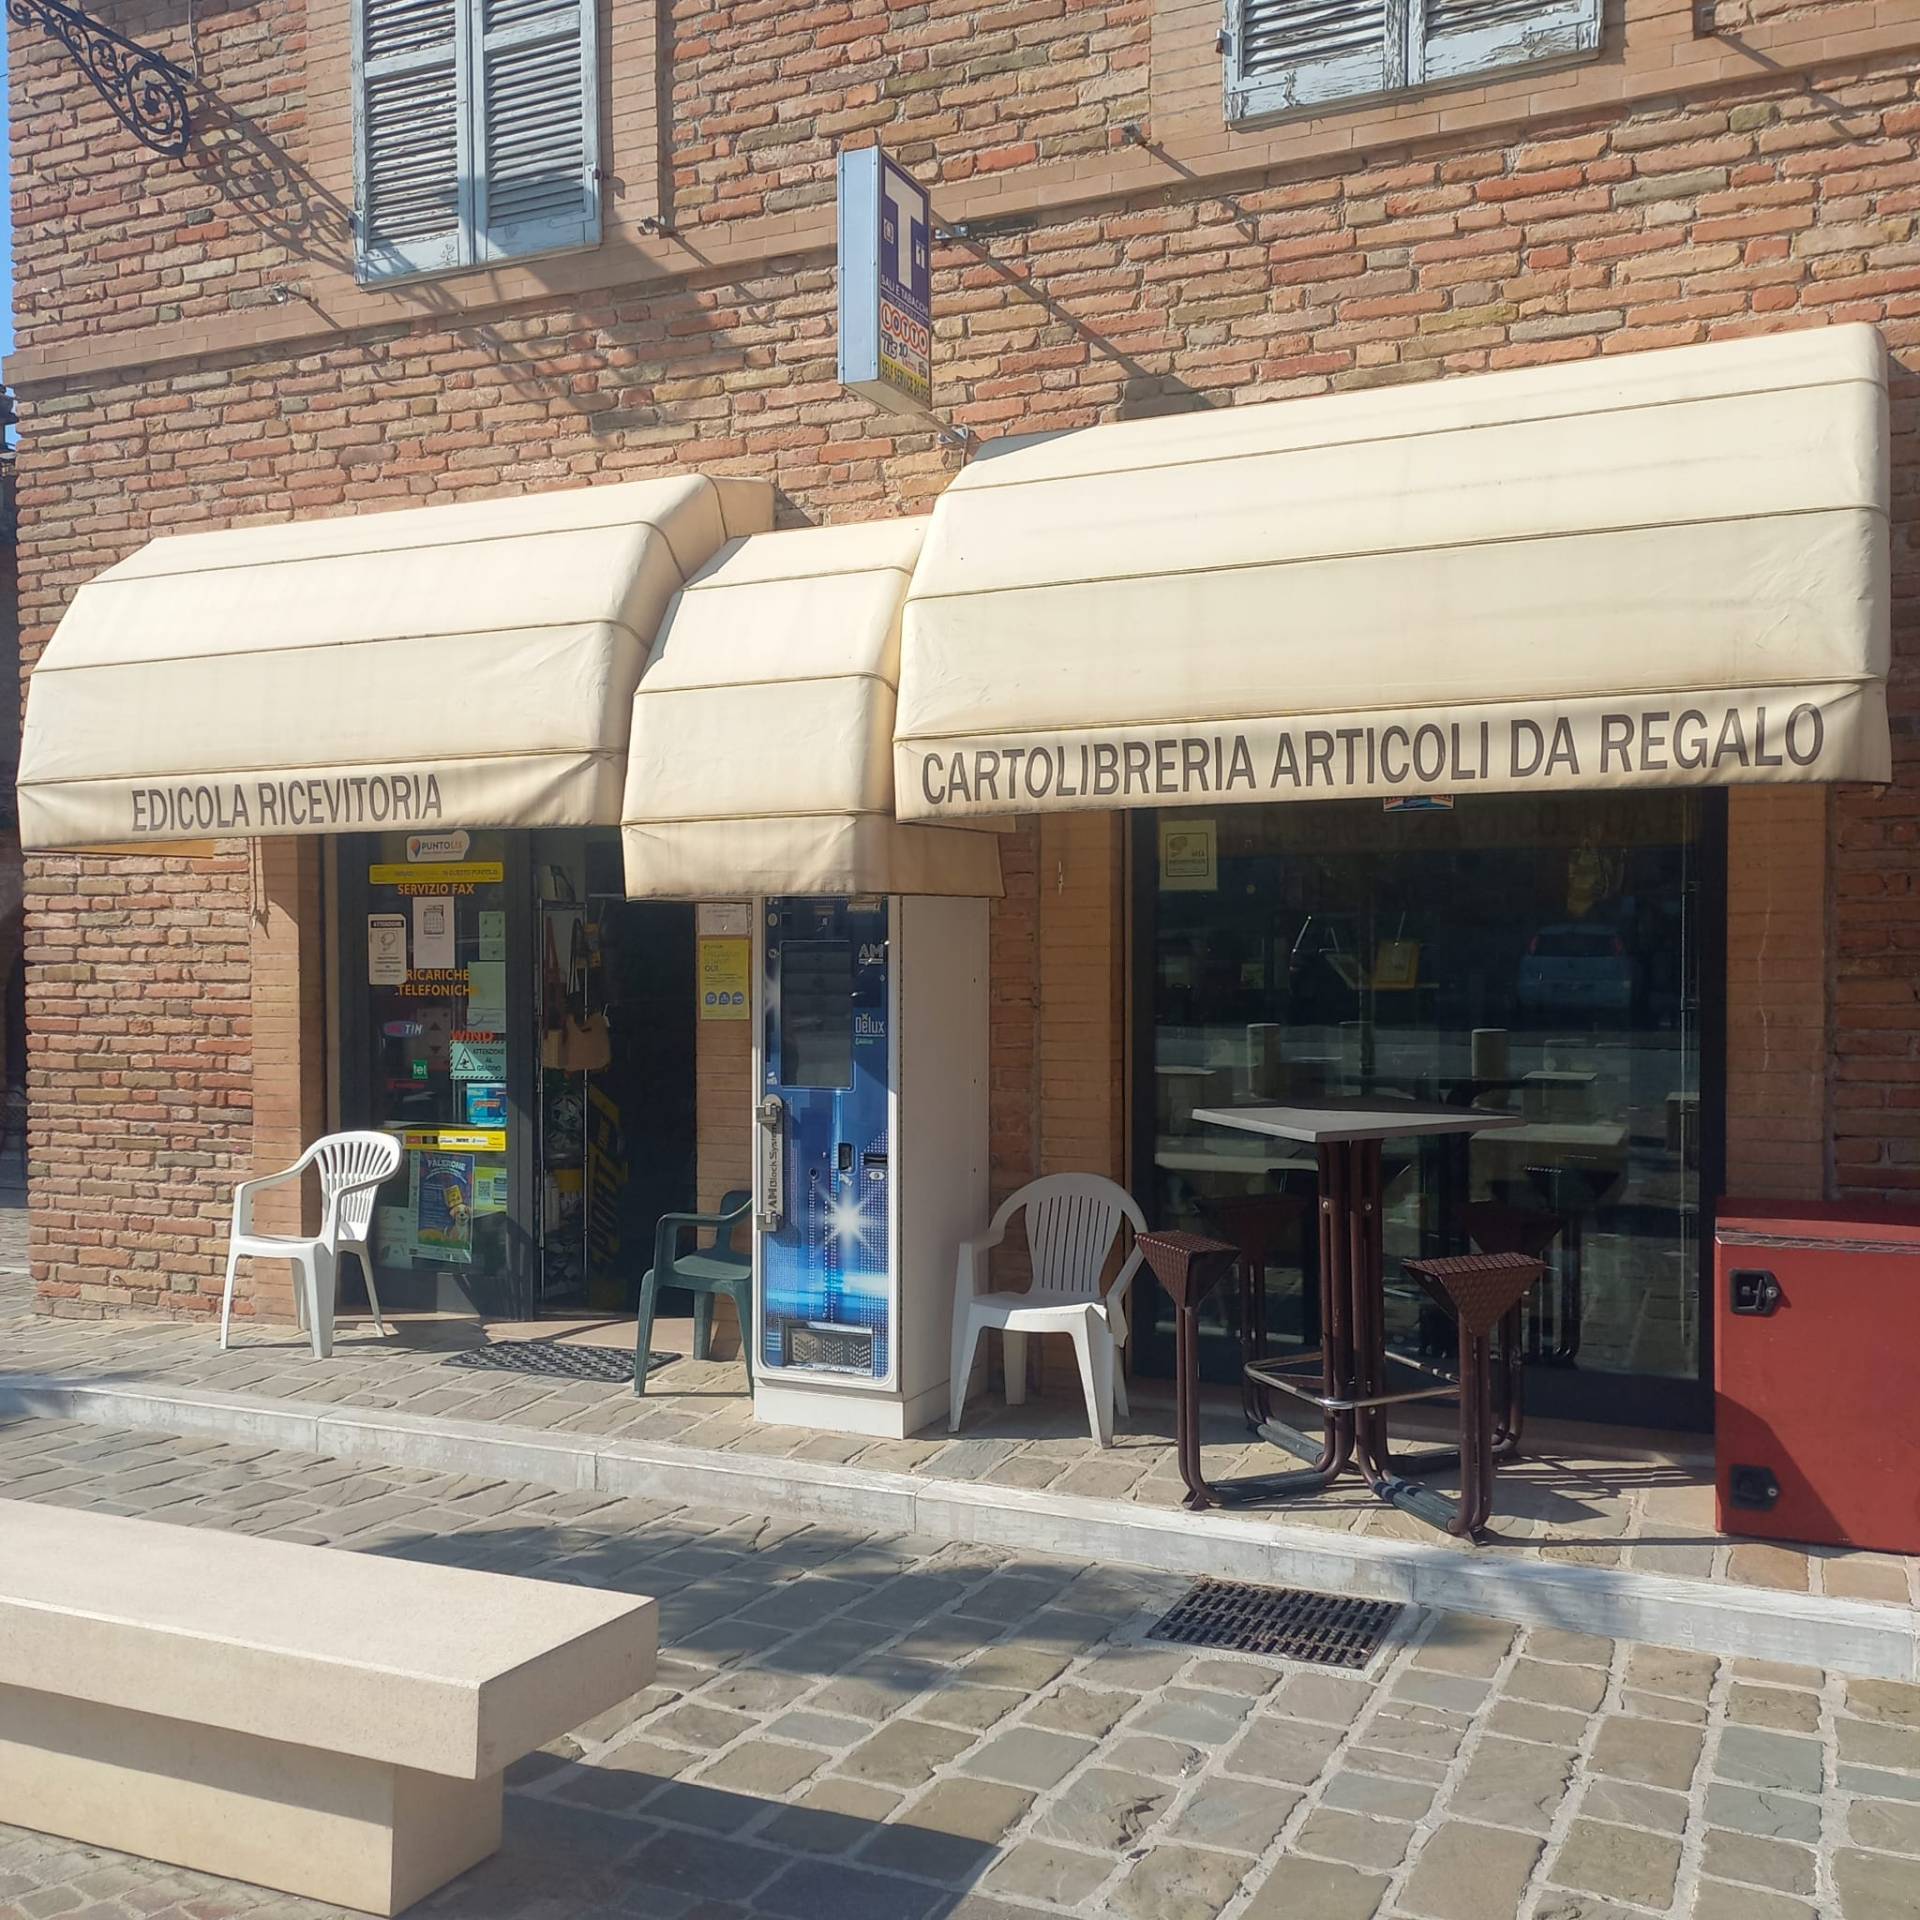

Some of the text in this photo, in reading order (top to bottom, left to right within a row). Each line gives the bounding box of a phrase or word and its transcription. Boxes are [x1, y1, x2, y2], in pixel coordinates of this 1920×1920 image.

[885, 165, 924, 291] T
[882, 304, 928, 354] LOTTO
[922, 703, 1824, 805] CARTOLIBRERIA ARTICOLI DA REGALO
[132, 774, 442, 832] EDICOLA RICEVITORIA
[397, 883, 475, 895] SERVIZIO FAX
[858, 944, 884, 958] AM
[405, 969, 470, 981] RICARICHE
[405, 1023, 423, 1035] TIM
[450, 1031, 495, 1041] WIND
